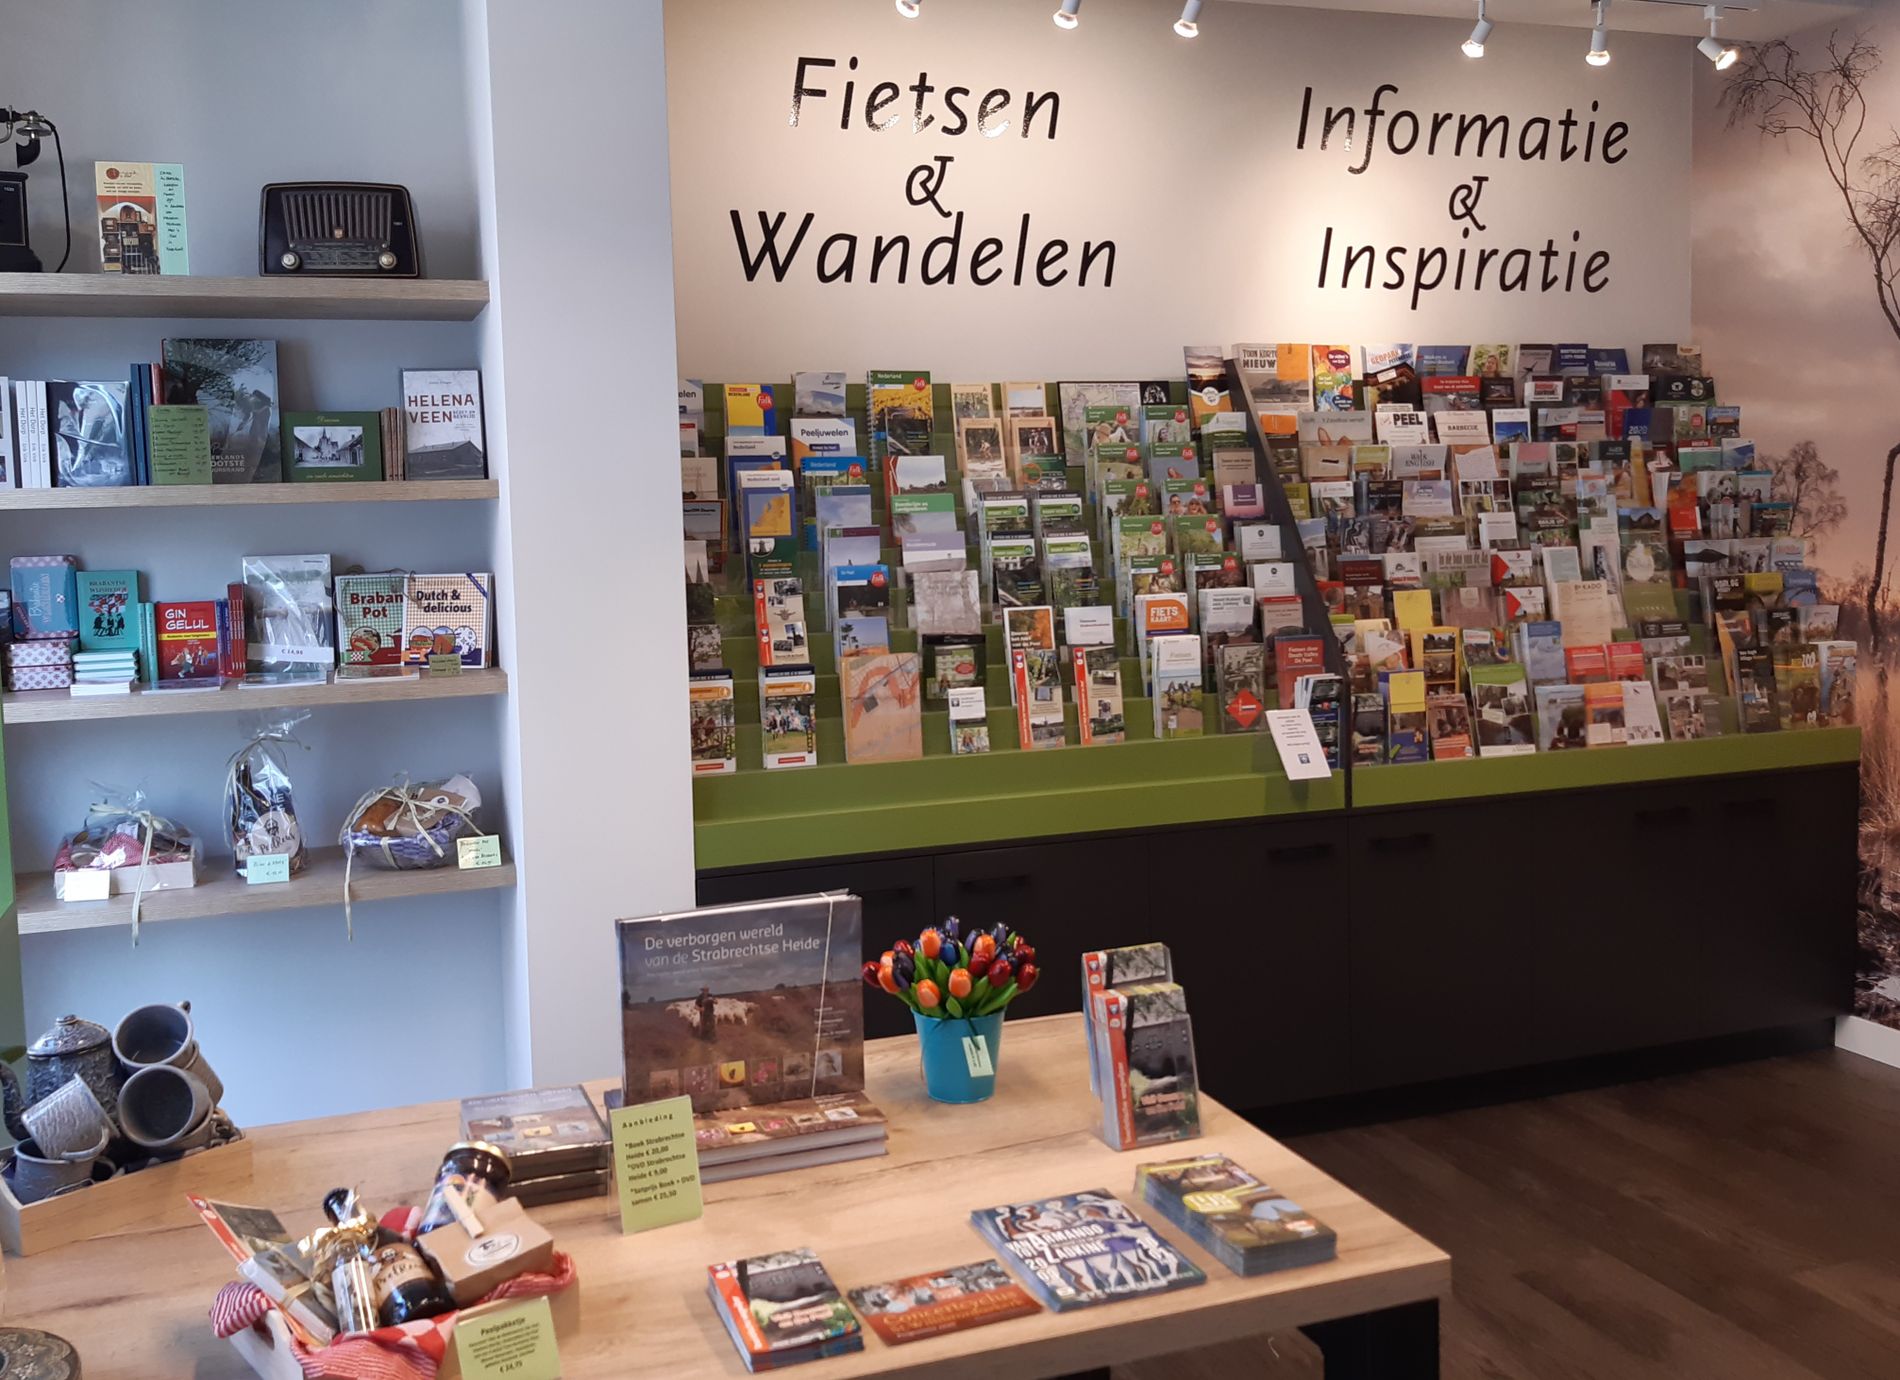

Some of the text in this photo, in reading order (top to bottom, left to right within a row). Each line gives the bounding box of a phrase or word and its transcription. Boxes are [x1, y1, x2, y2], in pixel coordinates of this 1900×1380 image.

[788, 56, 1061, 139] Fietsen
[1297, 84, 1629, 175] Informatie
[905, 156, 954, 217] &
[1448, 176, 1489, 231] &
[730, 209, 1116, 287] Wandelen
[1318, 227, 1610, 310] Inspiratie
[408, 394, 475, 407] HELENA
[757, 394, 773, 406] Falk
[409, 411, 452, 424] VEEN
[1392, 413, 1424, 426] PEEL
[800, 429, 849, 438] Peeljuwelen
[1628, 426, 1648, 435] 2020
[350, 591, 404, 606] Braban
[416, 589, 461, 601] Dutch &
[164, 608, 187, 619] GIN
[362, 606, 388, 619] Pot
[423, 602, 472, 614] delicious
[1151, 606, 1179, 617] FIETS
[165, 619, 210, 631] GELUL
[645, 924, 783, 951] De verborgen wereld
[645, 938, 820, 968] van de Strabrechtse Heide
[622, 1113, 673, 1129] Aanbieding
[626, 1152, 645, 1161] Heide
[628, 1172, 647, 1181] Heide
